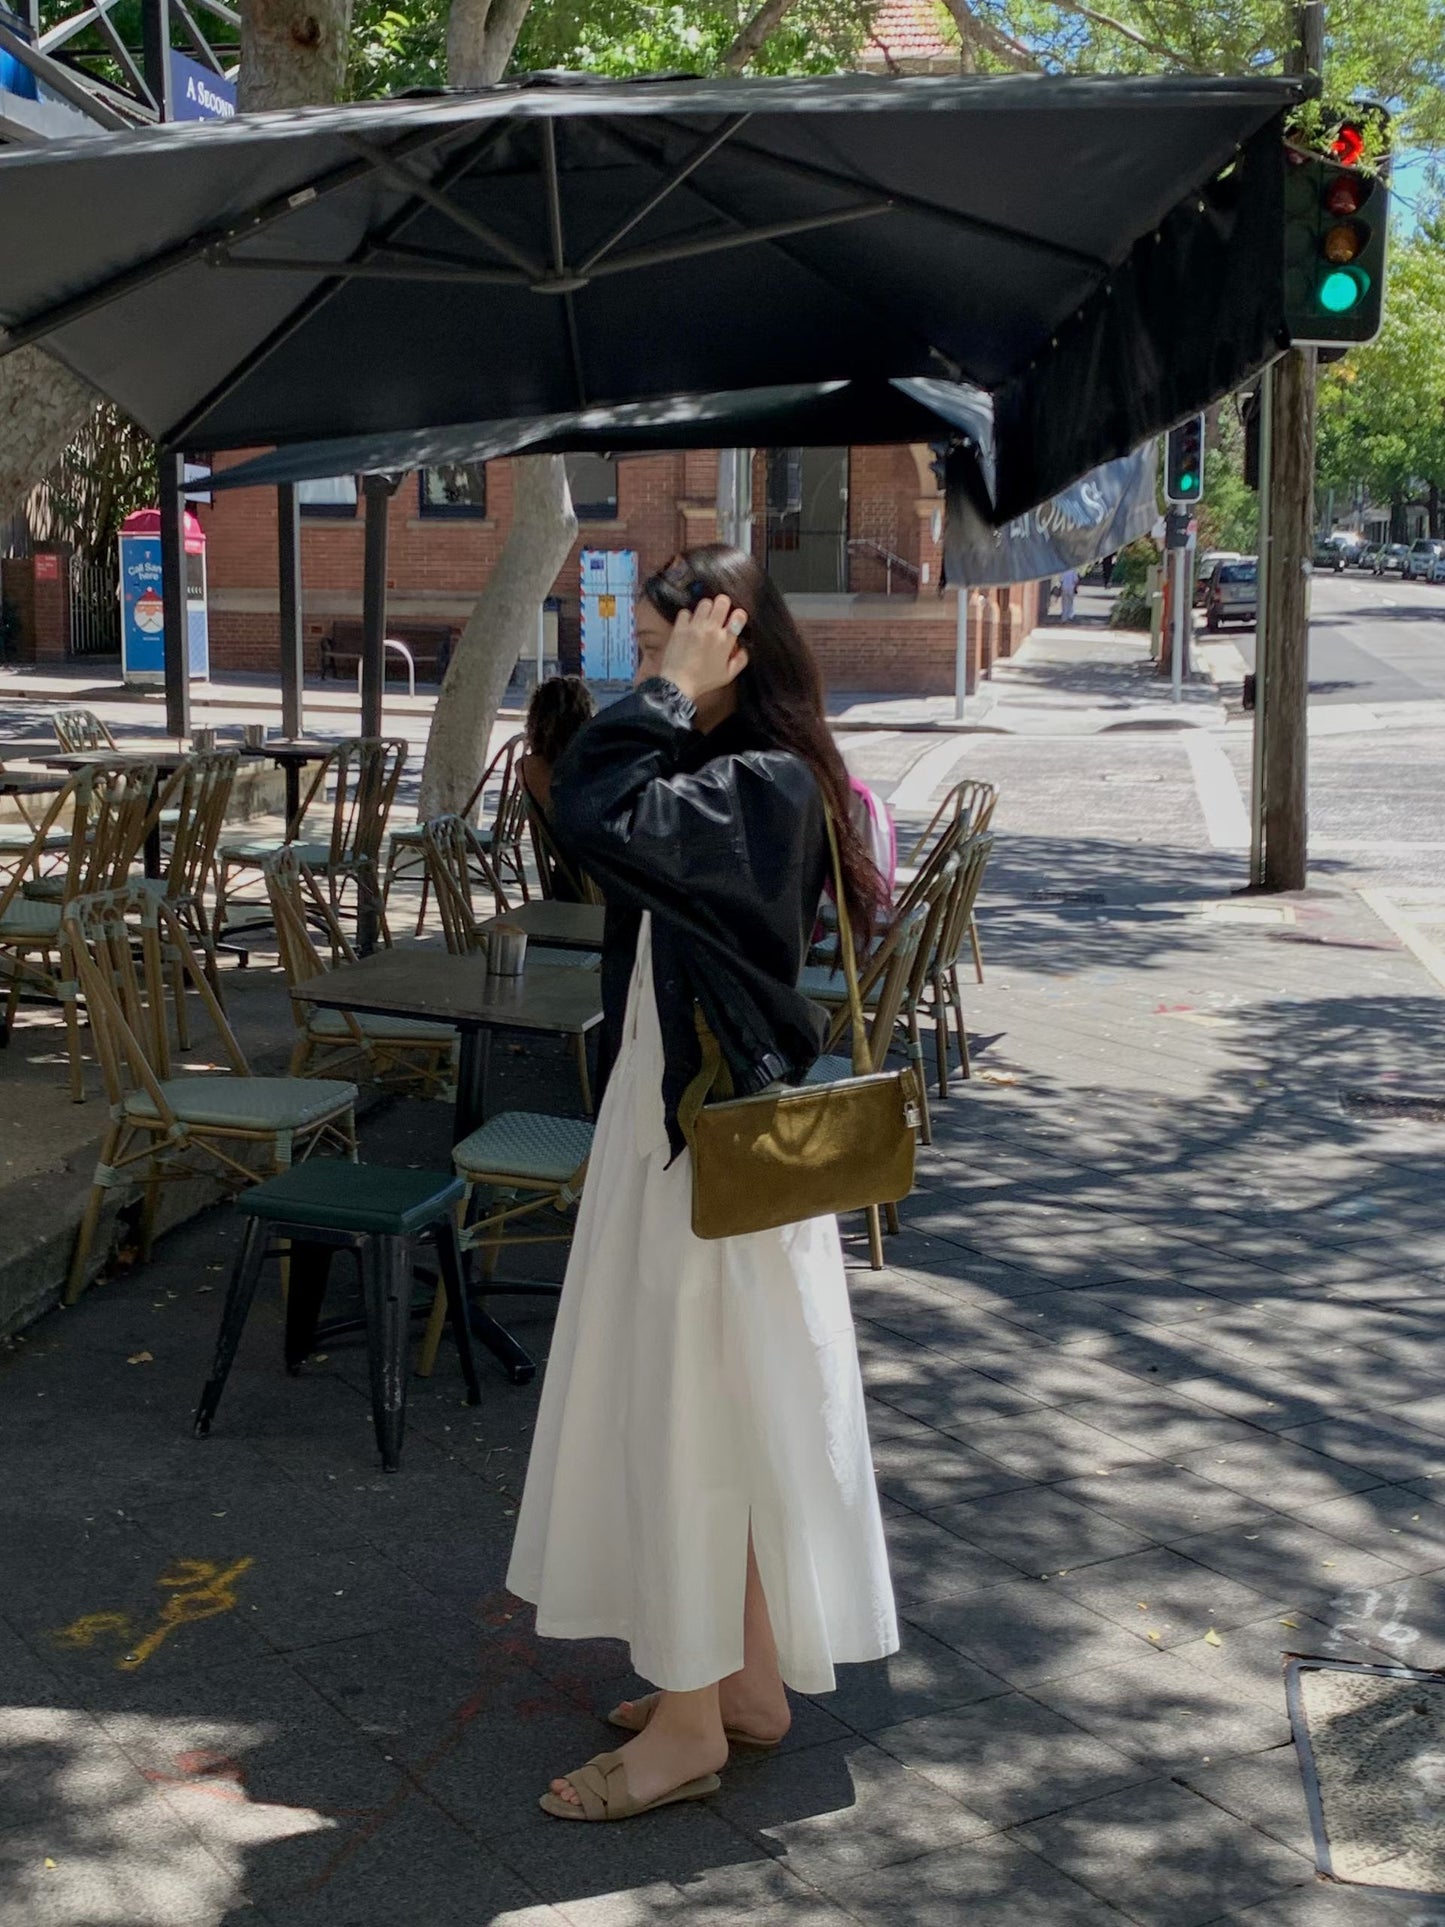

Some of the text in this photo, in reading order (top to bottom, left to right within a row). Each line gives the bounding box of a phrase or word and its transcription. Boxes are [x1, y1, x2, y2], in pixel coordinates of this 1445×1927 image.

[187, 77, 196, 101] A
[128, 563, 144, 576] Call
[138, 572, 159, 582] here
